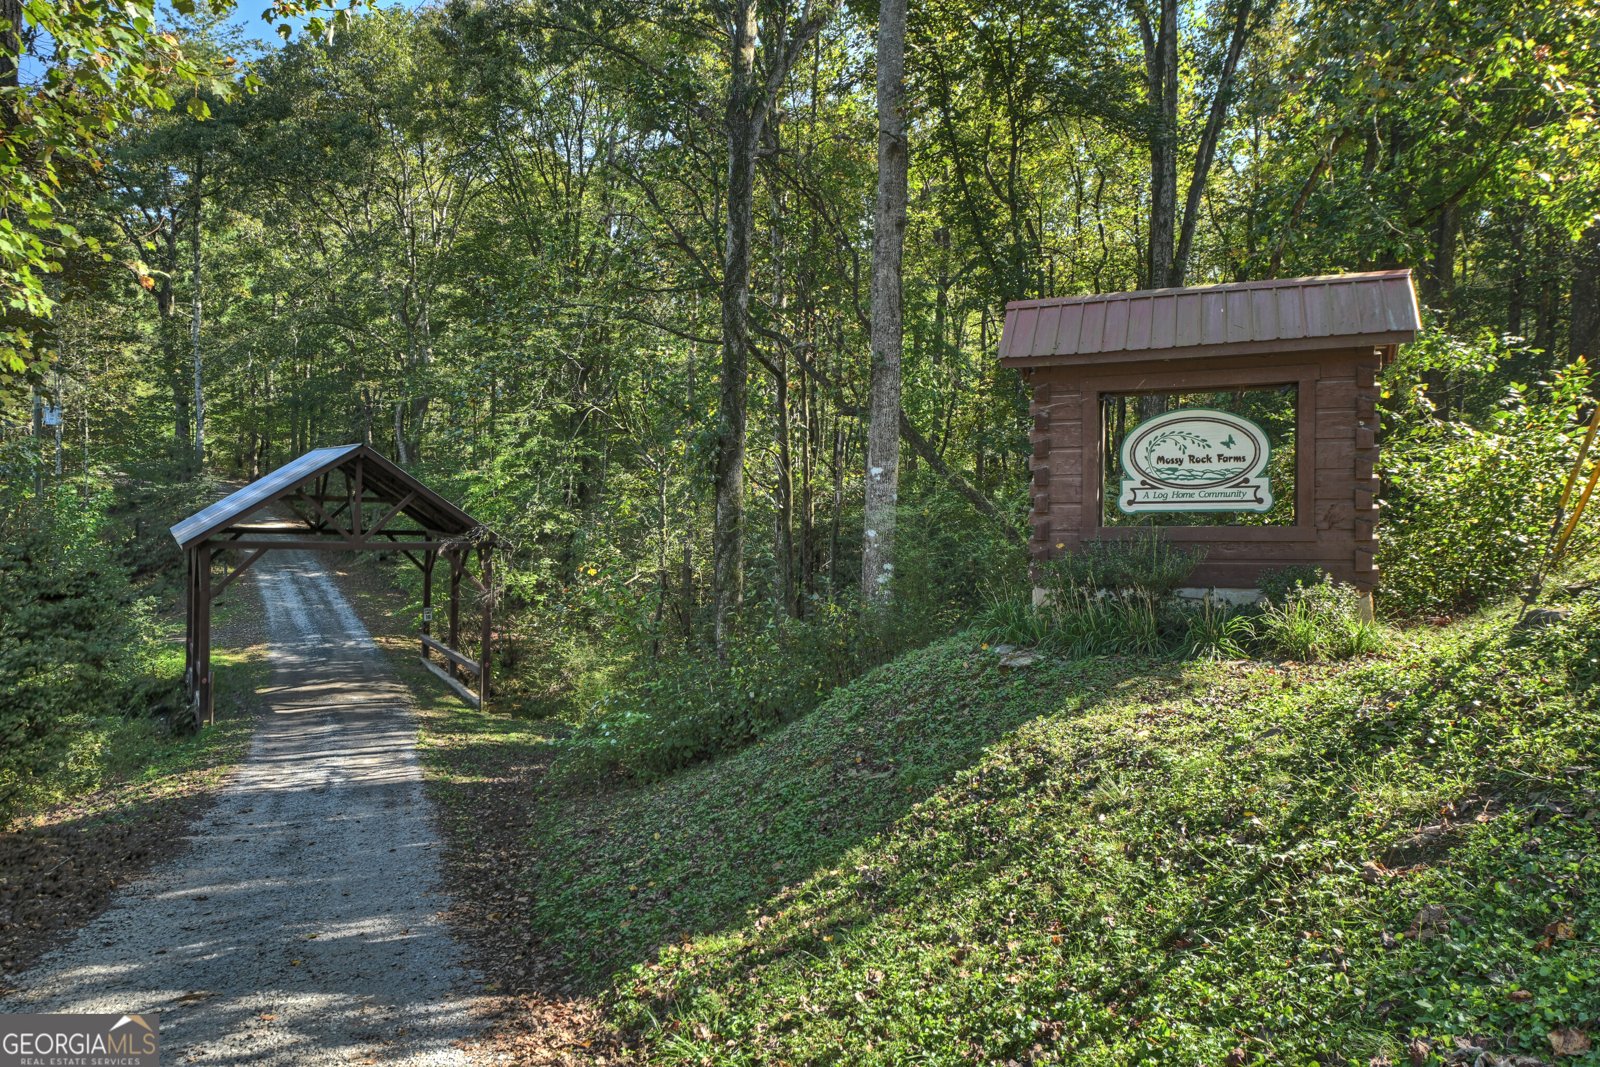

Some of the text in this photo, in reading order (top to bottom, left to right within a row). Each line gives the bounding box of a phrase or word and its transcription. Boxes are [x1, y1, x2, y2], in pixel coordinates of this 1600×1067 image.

[1156, 454, 1246, 466] Mossy Rock Farms
[1143, 489, 1248, 500] A Log Home Community
